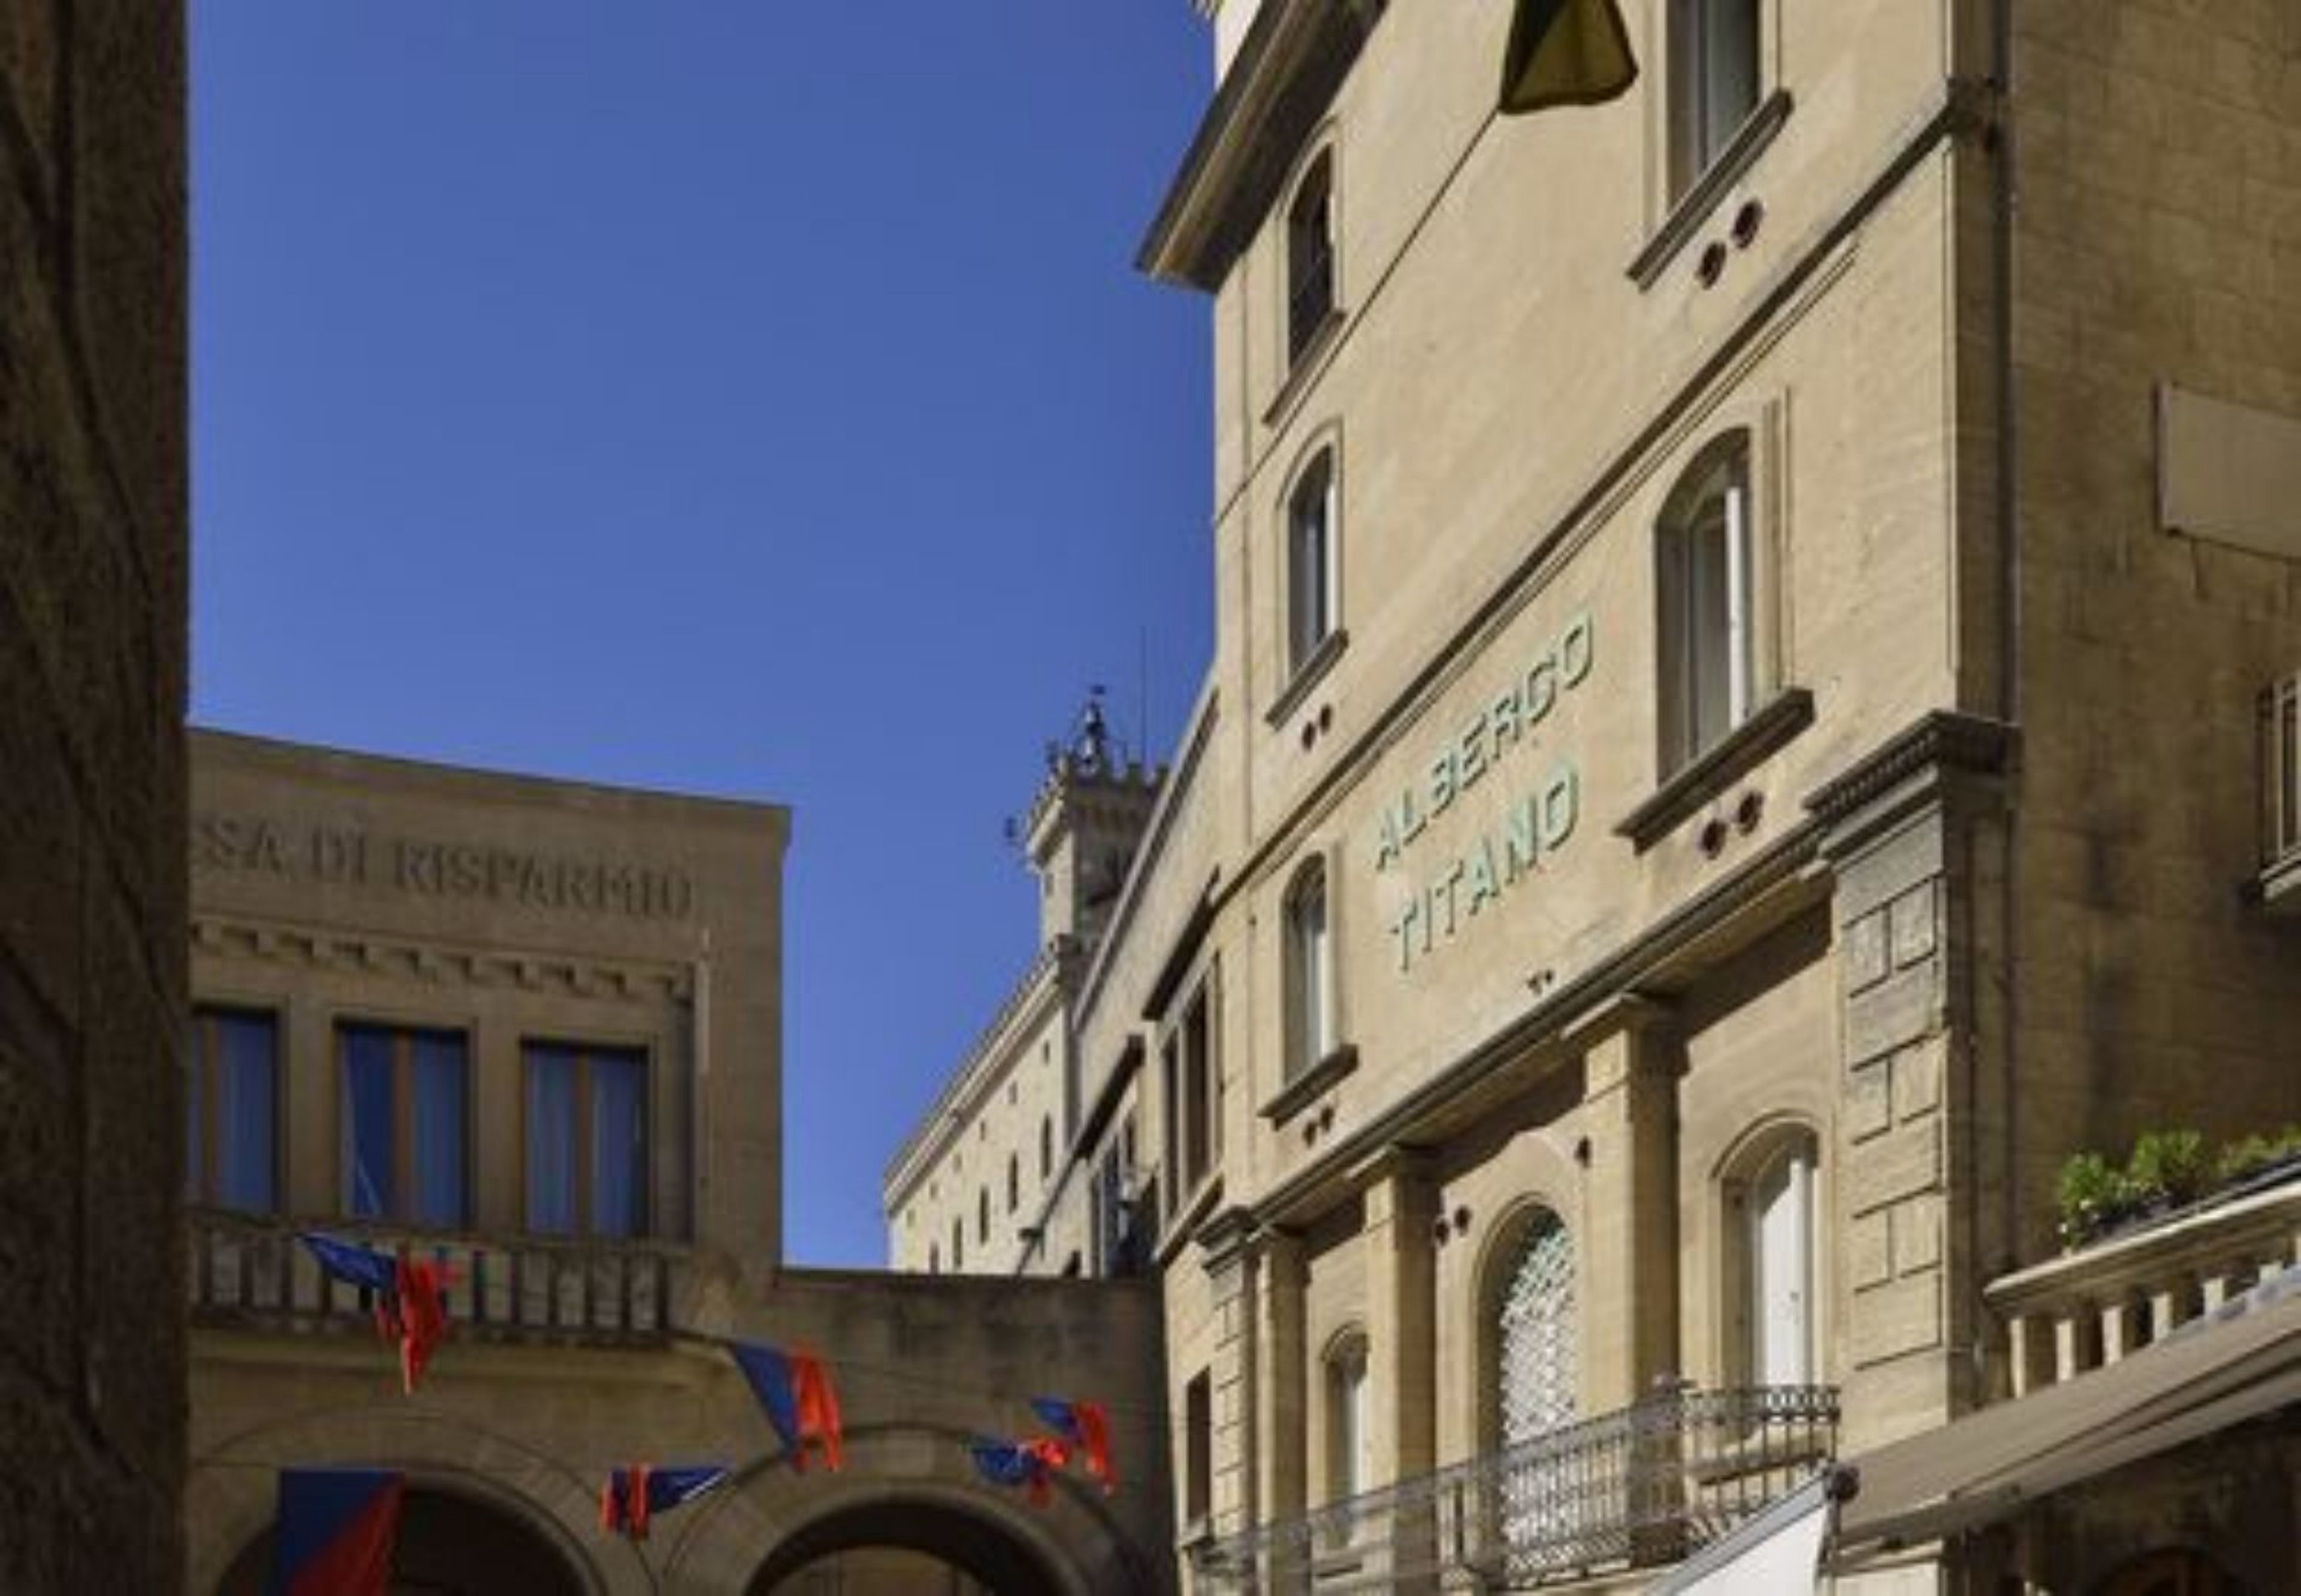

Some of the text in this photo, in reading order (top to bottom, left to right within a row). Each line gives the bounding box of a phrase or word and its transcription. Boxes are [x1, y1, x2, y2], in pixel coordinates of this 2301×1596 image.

[1372, 610, 1594, 872] ALBERGO
[310, 823, 368, 887] DI
[391, 838, 694, 921] RISPARMIO
[1389, 762, 1580, 973] TITANO
